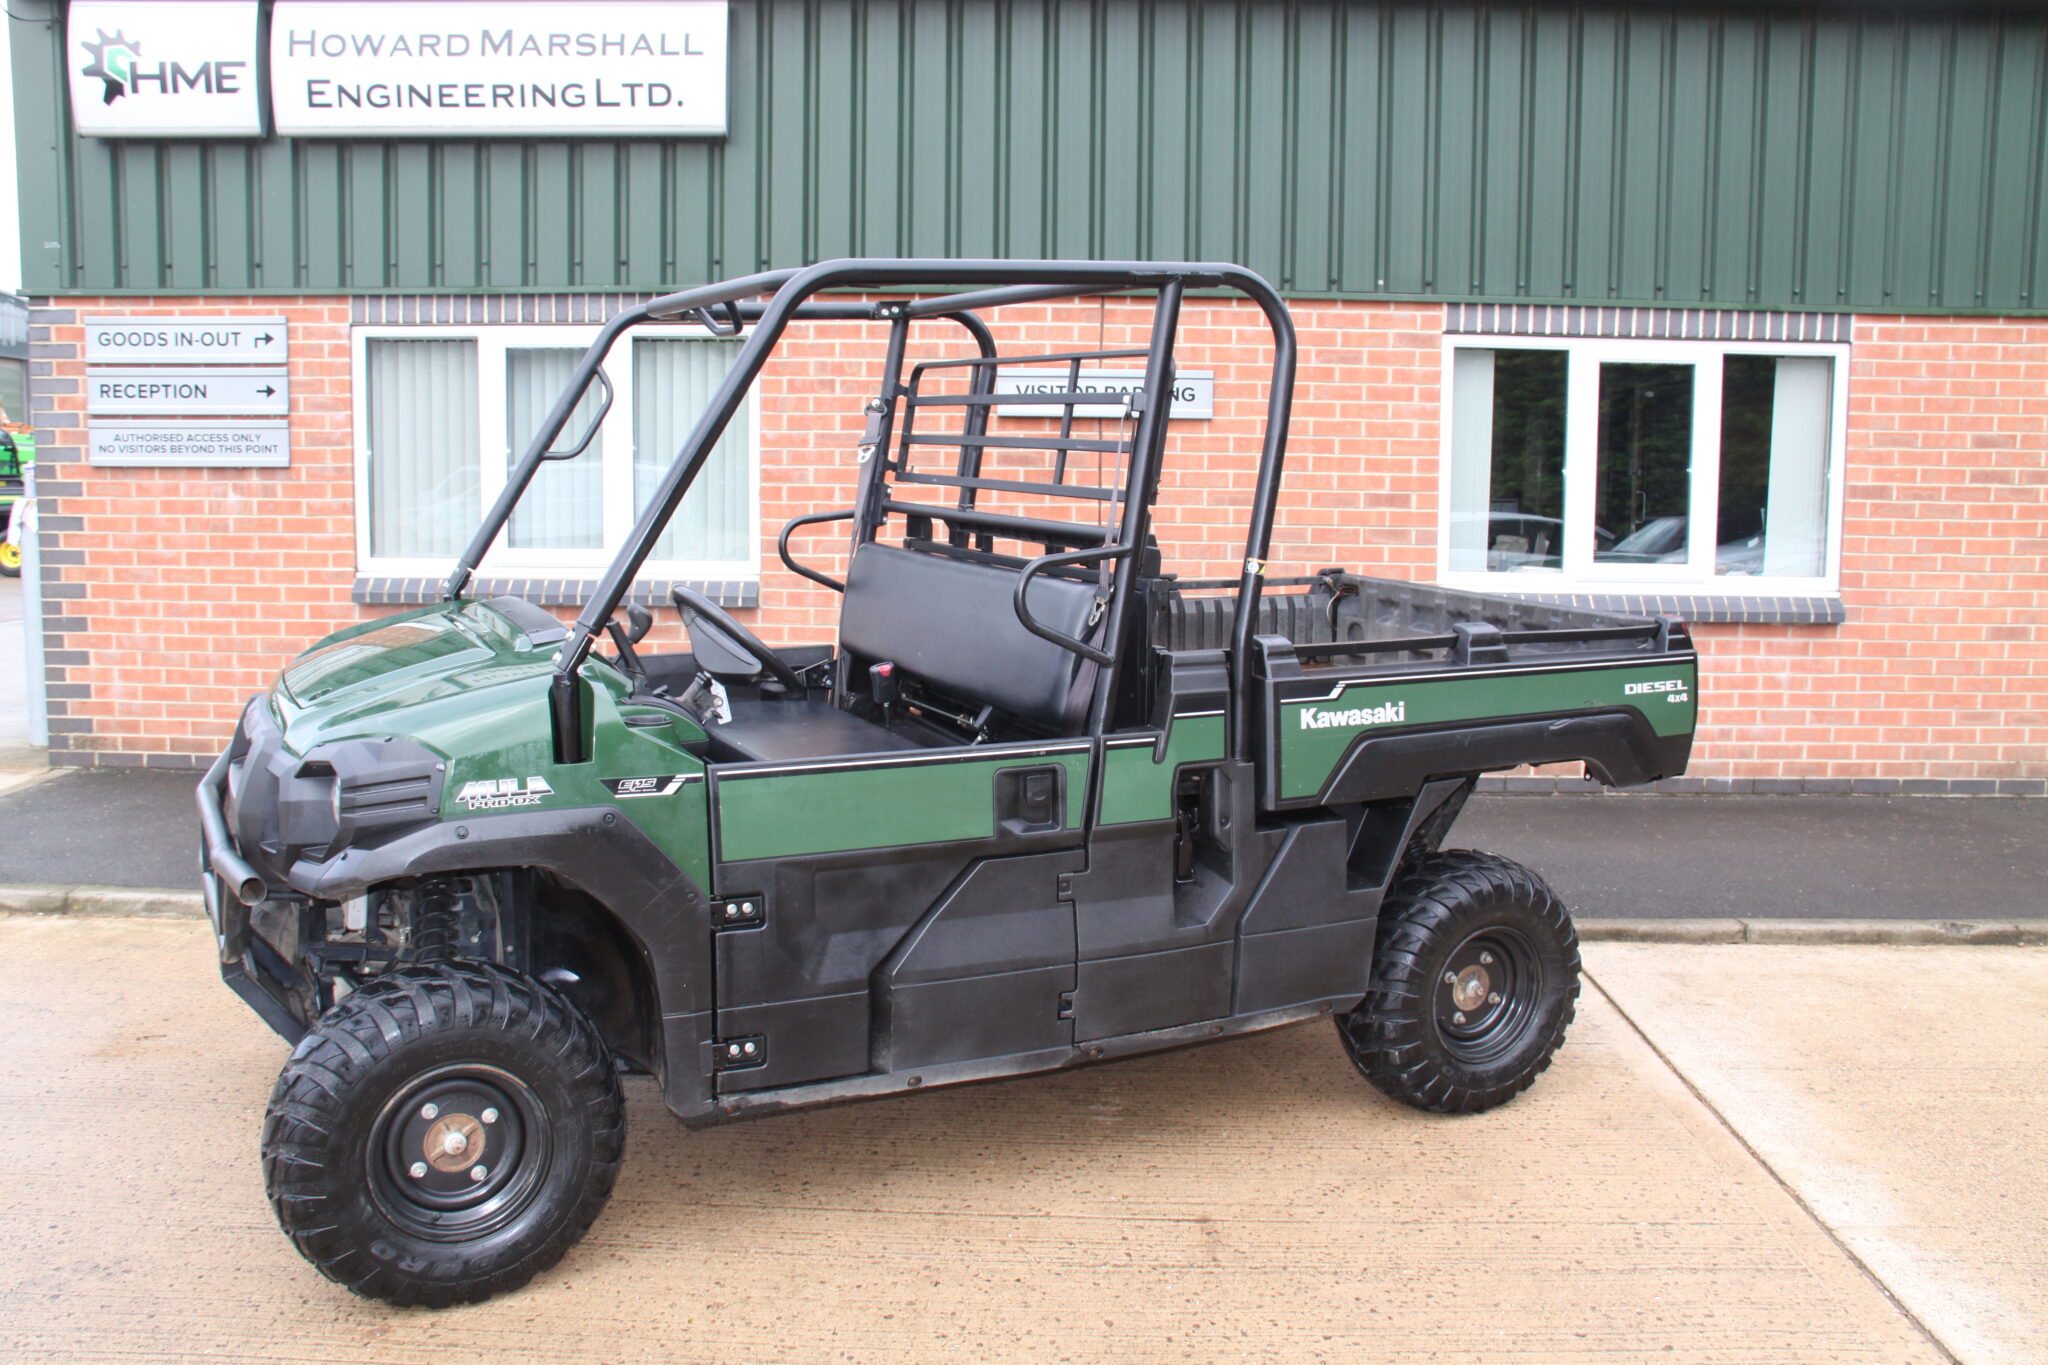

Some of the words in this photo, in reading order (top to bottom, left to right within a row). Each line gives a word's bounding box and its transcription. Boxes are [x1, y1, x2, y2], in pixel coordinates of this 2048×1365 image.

[288, 29, 469, 57] HOWARD
[480, 29, 704, 57] MARSHALL
[129, 61, 246, 94] HME
[307, 79, 586, 108] ENGINEERING
[596, 78, 684, 108] LTD.
[98, 332, 168, 347] GOODS
[174, 332, 242, 347] IN-OUT
[99, 384, 208, 399] RECEPTION
[114, 433, 184, 443] AUTHORISED
[186, 433, 229, 443] ACCESS
[232, 434, 262, 443] ONLY
[99, 445, 116, 454] NO
[117, 444, 168, 454] VISITORS
[171, 444, 216, 454] BEYOND
[219, 444, 243, 454] THIS
[246, 444, 278, 454] POINT
[1624, 679, 1688, 695] DIESEL
[1667, 692, 1688, 703] 4x4
[1300, 701, 1405, 730] Kawasaki
